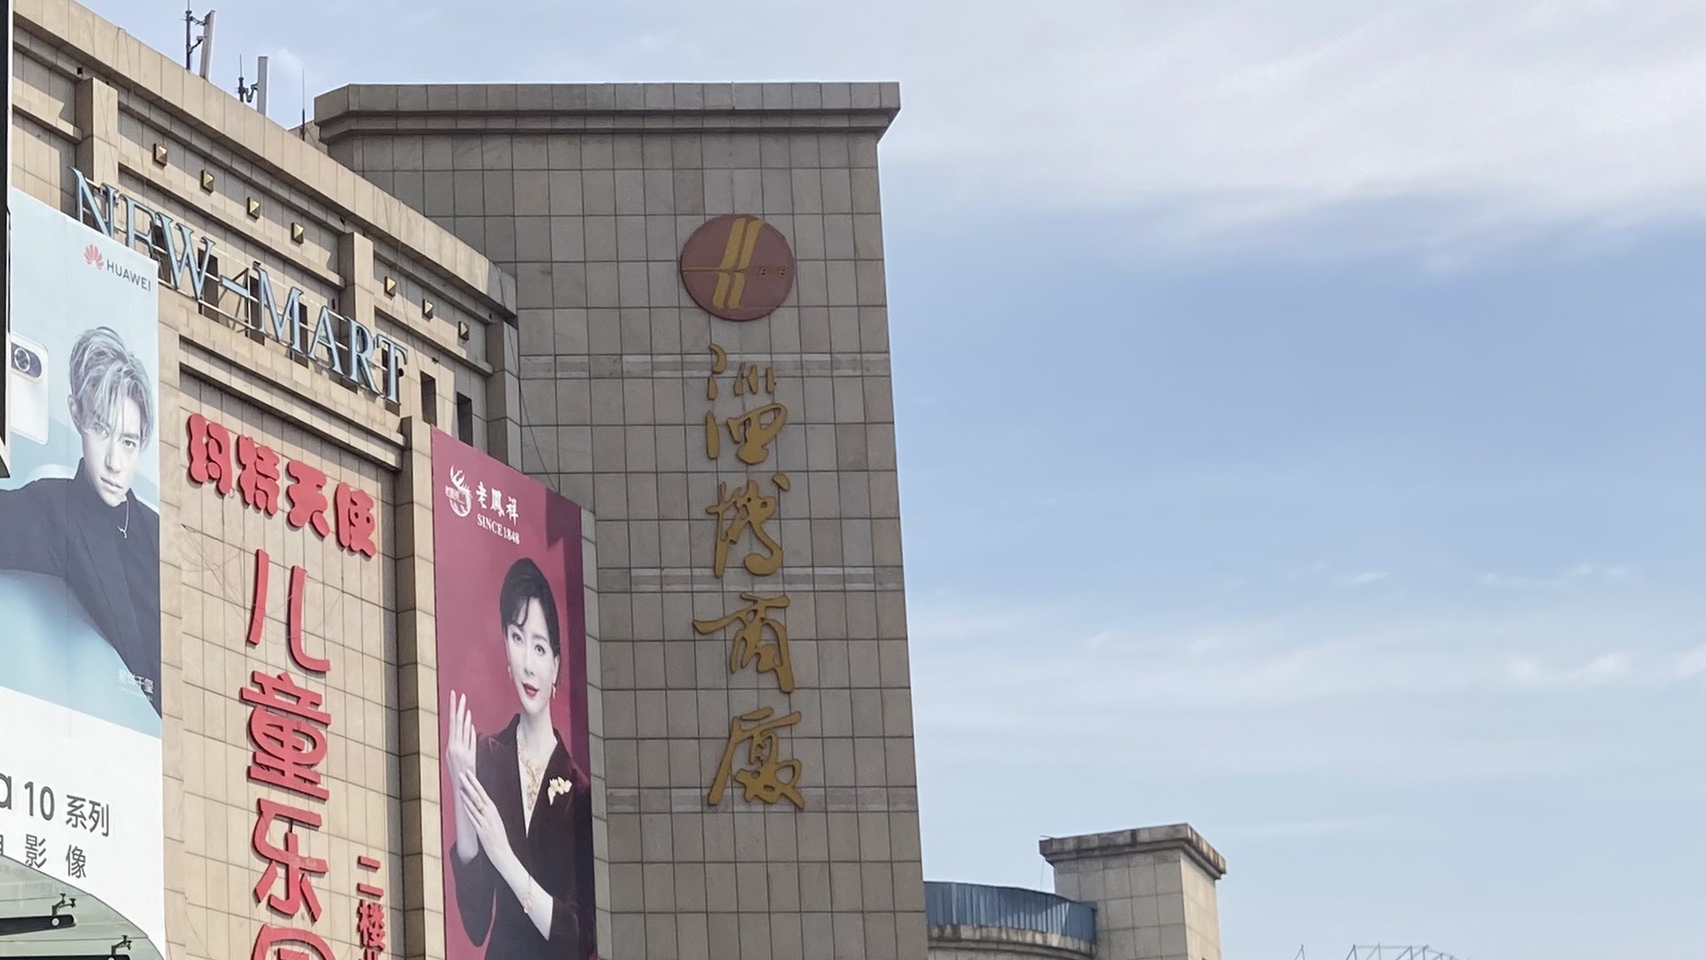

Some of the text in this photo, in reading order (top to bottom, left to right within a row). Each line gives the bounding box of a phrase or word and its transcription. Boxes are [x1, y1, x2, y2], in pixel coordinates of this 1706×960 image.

[106, 259, 151, 292] HUAWEI
[186, 413, 377, 559] 玛特天使
[24, 781, 55, 822] 10
[65, 794, 110, 837] 系列
